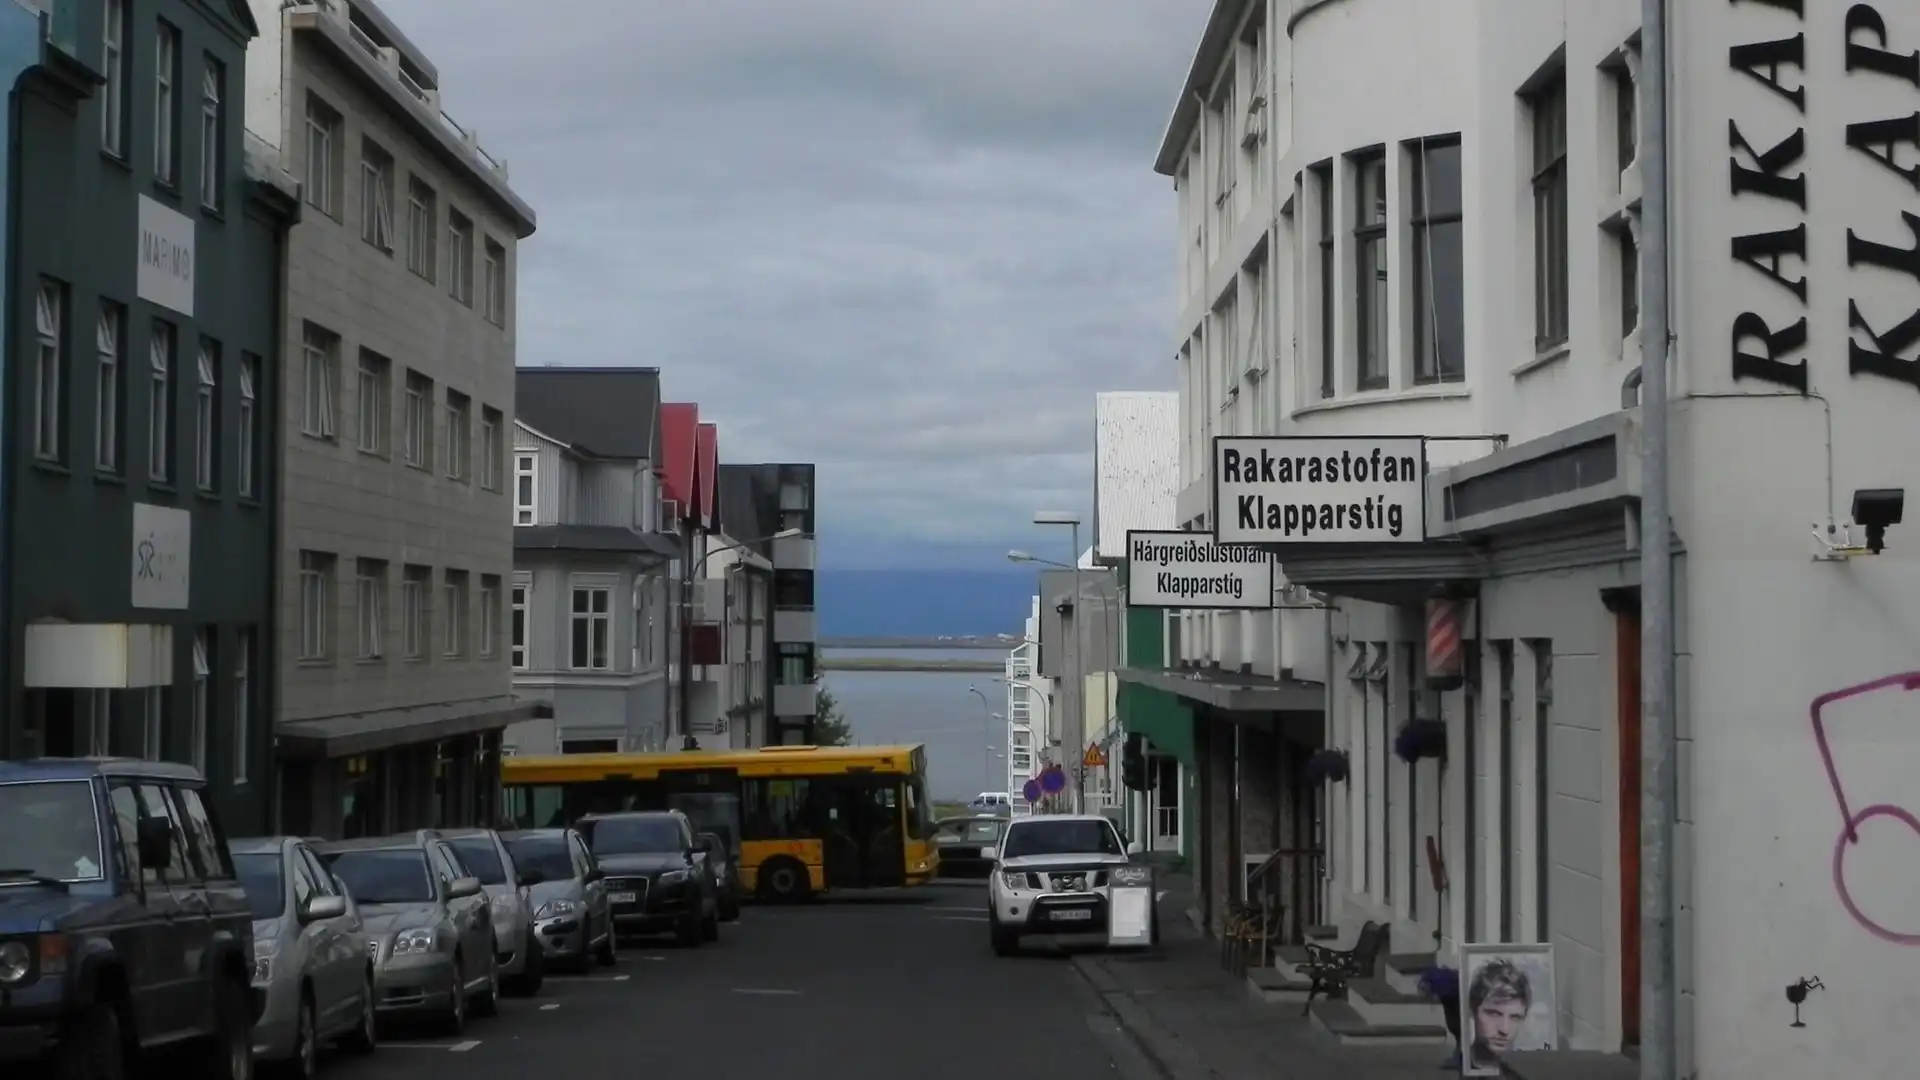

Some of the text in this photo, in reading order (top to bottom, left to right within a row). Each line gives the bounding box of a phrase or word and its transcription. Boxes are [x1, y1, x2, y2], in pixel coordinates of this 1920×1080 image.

[1729, 0, 1809, 397] RAKA
[1223, 448, 1415, 483] Rakarastofan
[1238, 494, 1403, 537] Klapparstíg
[1157, 572, 1242, 599] Klapparstíg
